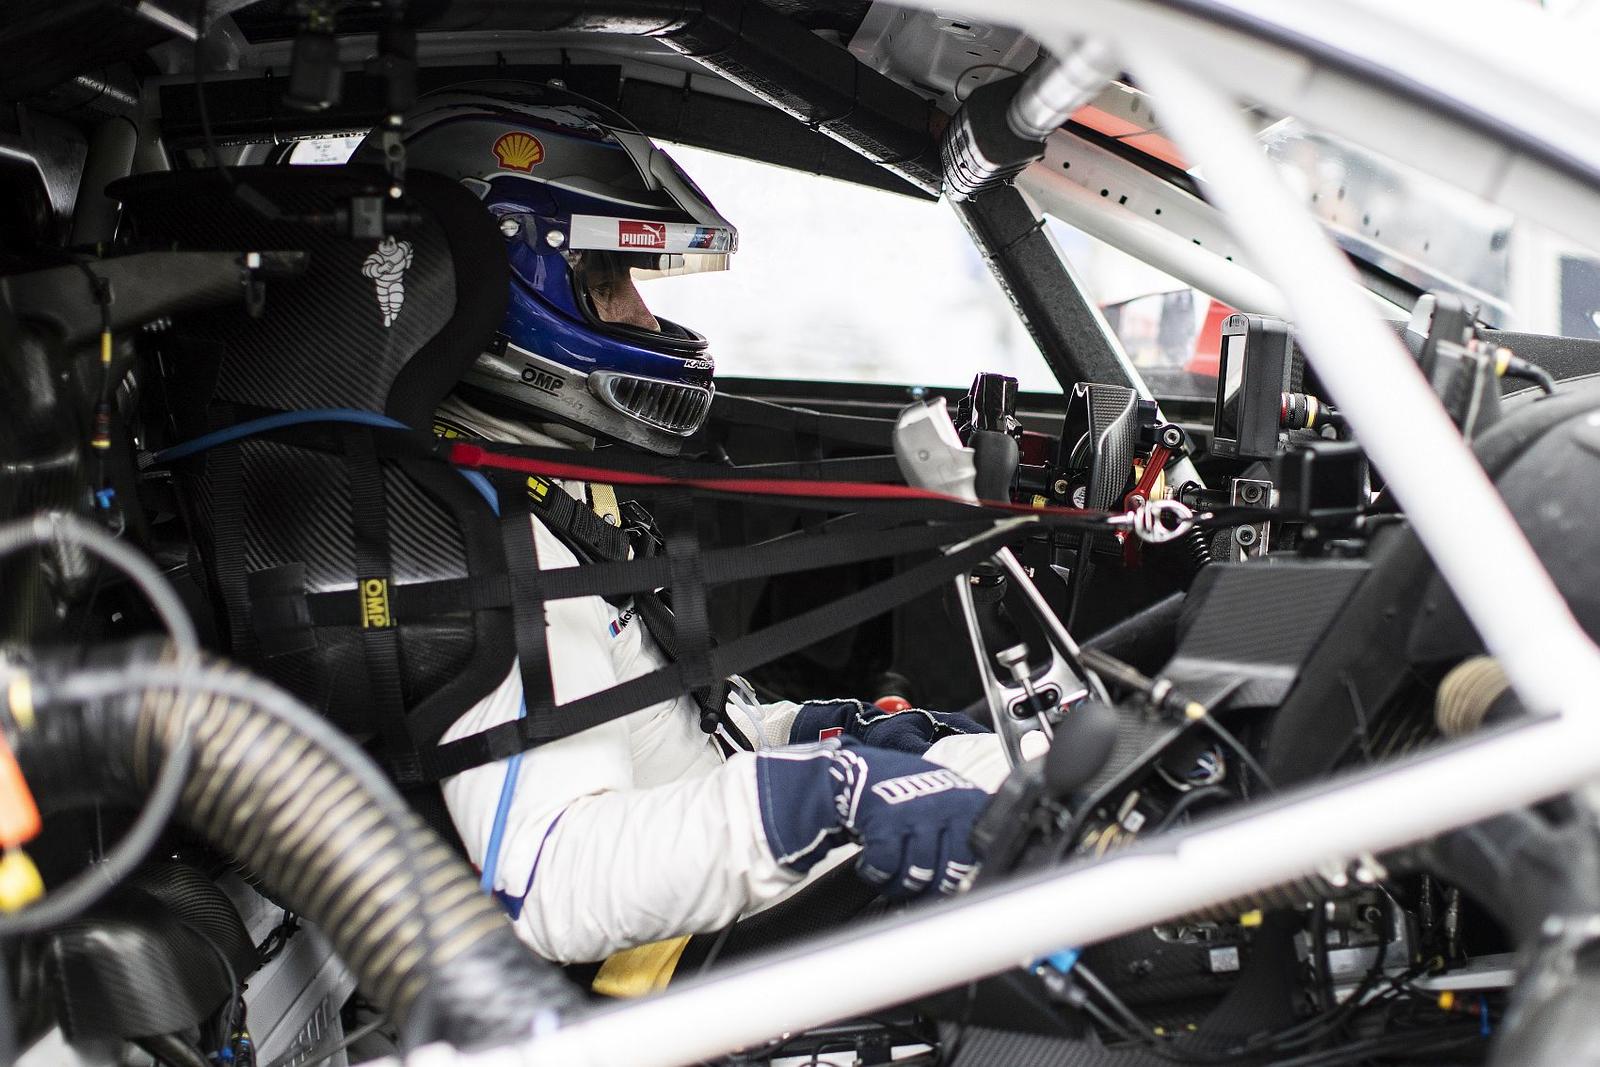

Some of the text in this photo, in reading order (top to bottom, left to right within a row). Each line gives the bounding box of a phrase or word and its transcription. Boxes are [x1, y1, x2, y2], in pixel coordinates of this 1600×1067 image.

[621, 232, 655, 246] PUMA
[521, 368, 564, 391] OMP
[366, 579, 386, 627] OMP
